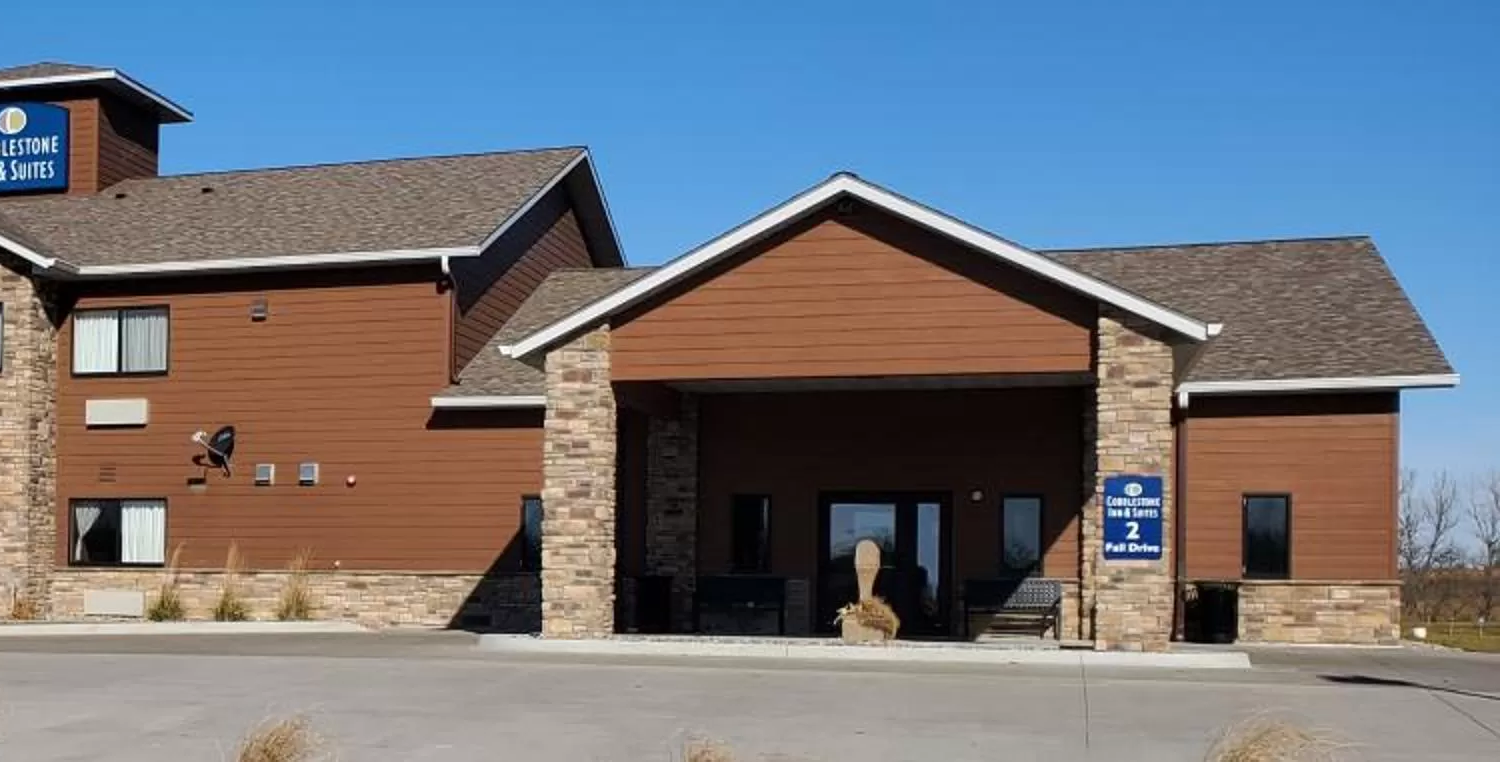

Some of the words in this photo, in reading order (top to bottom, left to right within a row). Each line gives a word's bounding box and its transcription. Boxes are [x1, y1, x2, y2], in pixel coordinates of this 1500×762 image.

[11, 160, 55, 180] SUITES
[1106, 495, 1161, 507] COBBLESTONE
[1107, 507, 1122, 518] INN
[1132, 507, 1159, 518] SUITES
[1125, 521, 1140, 540] 2
[1128, 542, 1160, 553] Drive
